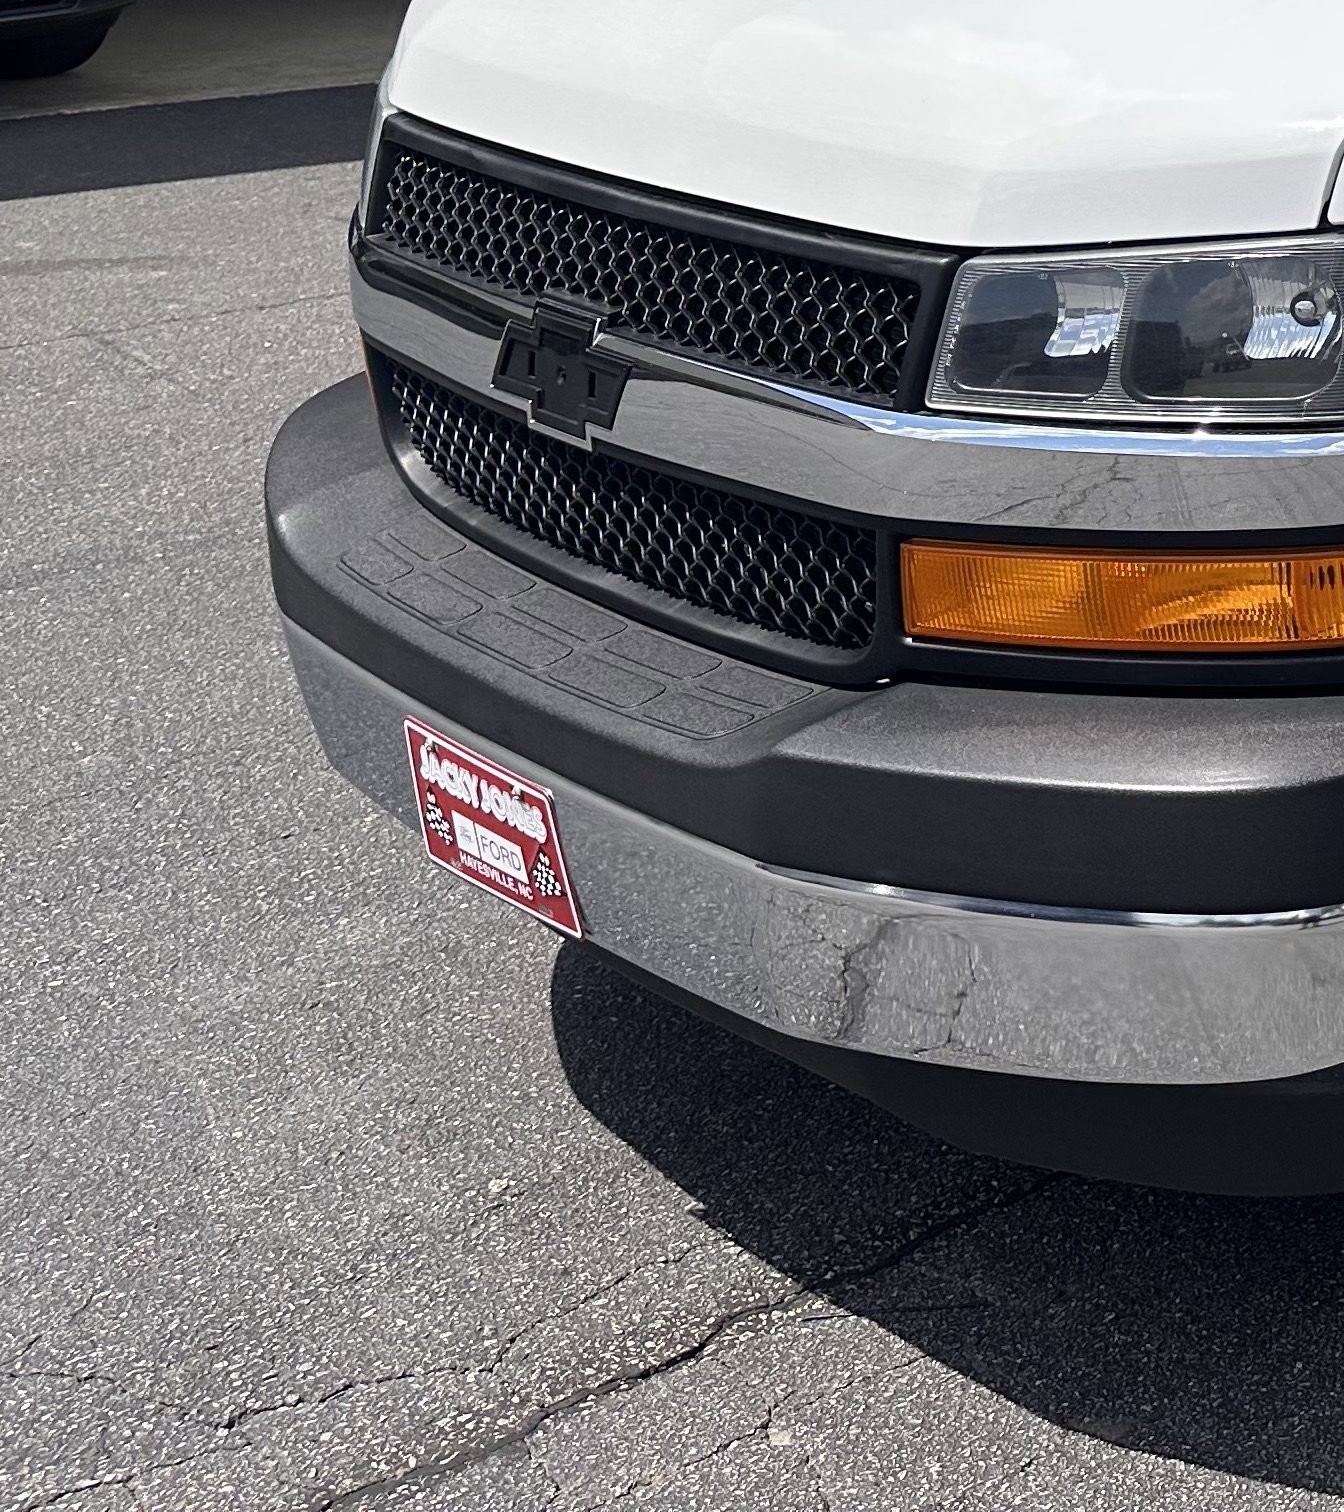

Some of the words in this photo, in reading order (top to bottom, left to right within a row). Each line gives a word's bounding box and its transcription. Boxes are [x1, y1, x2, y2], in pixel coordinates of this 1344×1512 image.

[420, 744, 480, 809] JACKY
[480, 778, 548, 845] JONES
[480, 834, 522, 872] FORD
